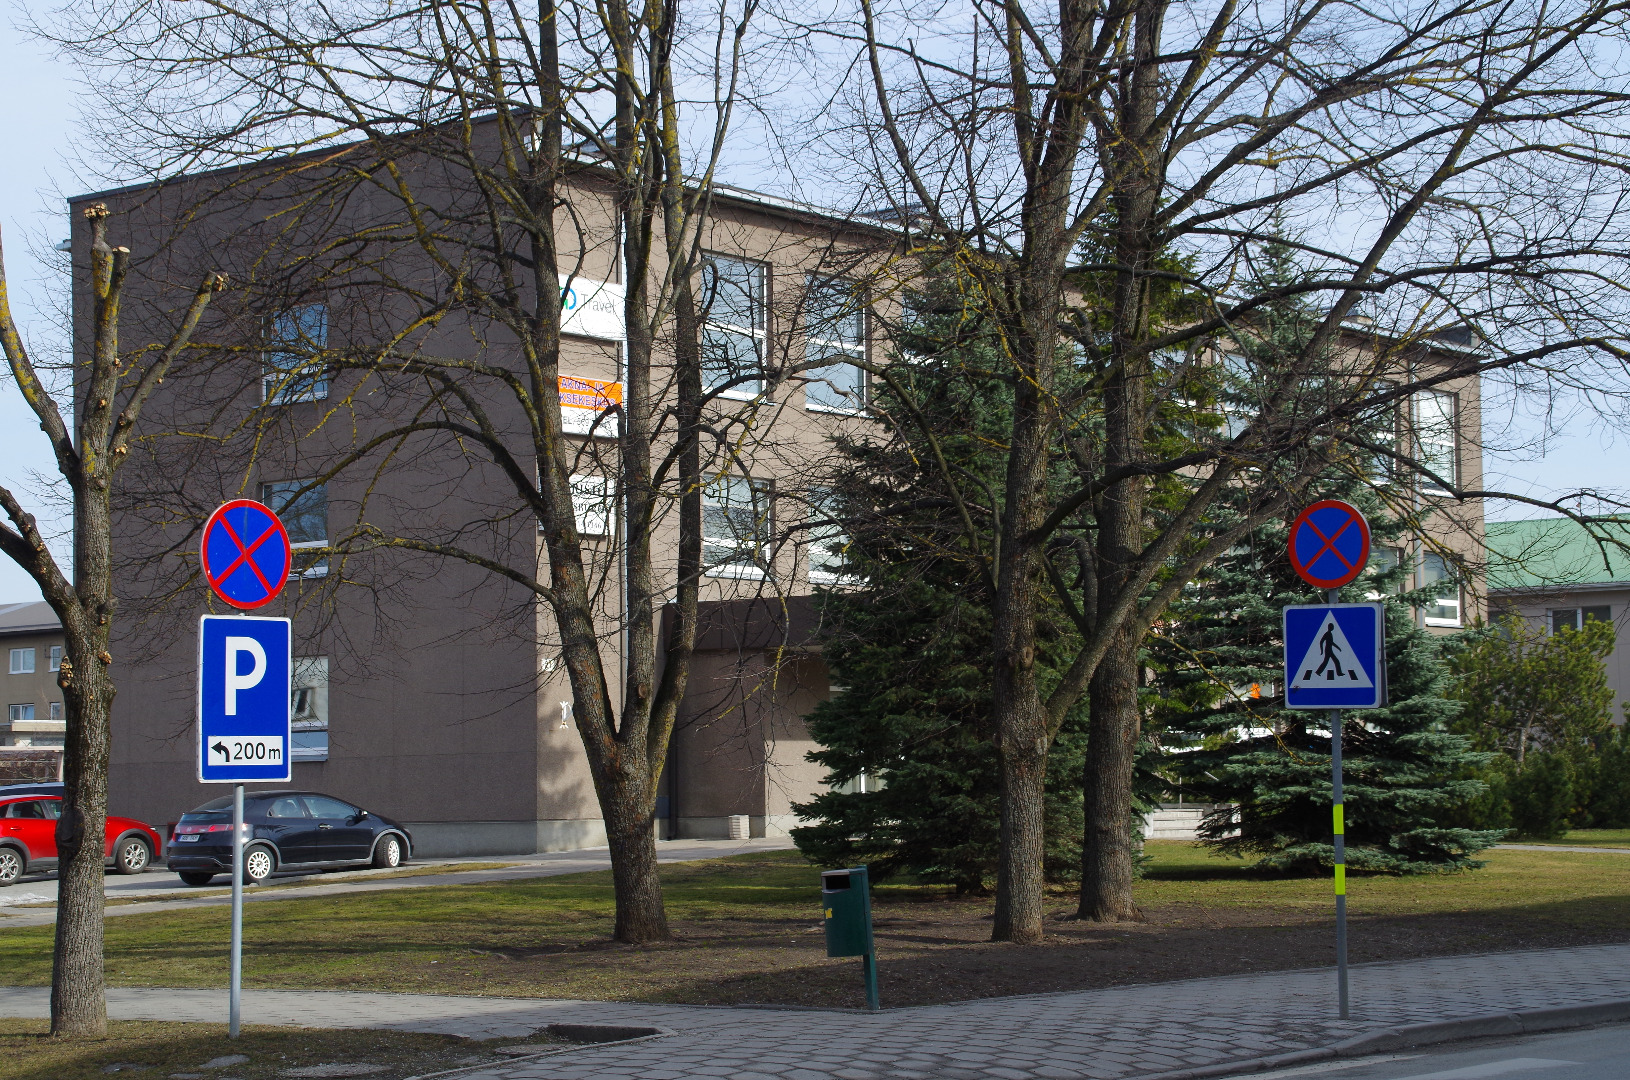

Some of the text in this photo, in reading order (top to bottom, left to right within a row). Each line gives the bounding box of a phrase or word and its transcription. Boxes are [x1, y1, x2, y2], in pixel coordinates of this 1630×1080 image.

[581, 293, 615, 315] Travel
[559, 392, 615, 409] KSEKESKUS
[225, 636, 267, 716] P
[234, 742, 281, 760] 200 m
